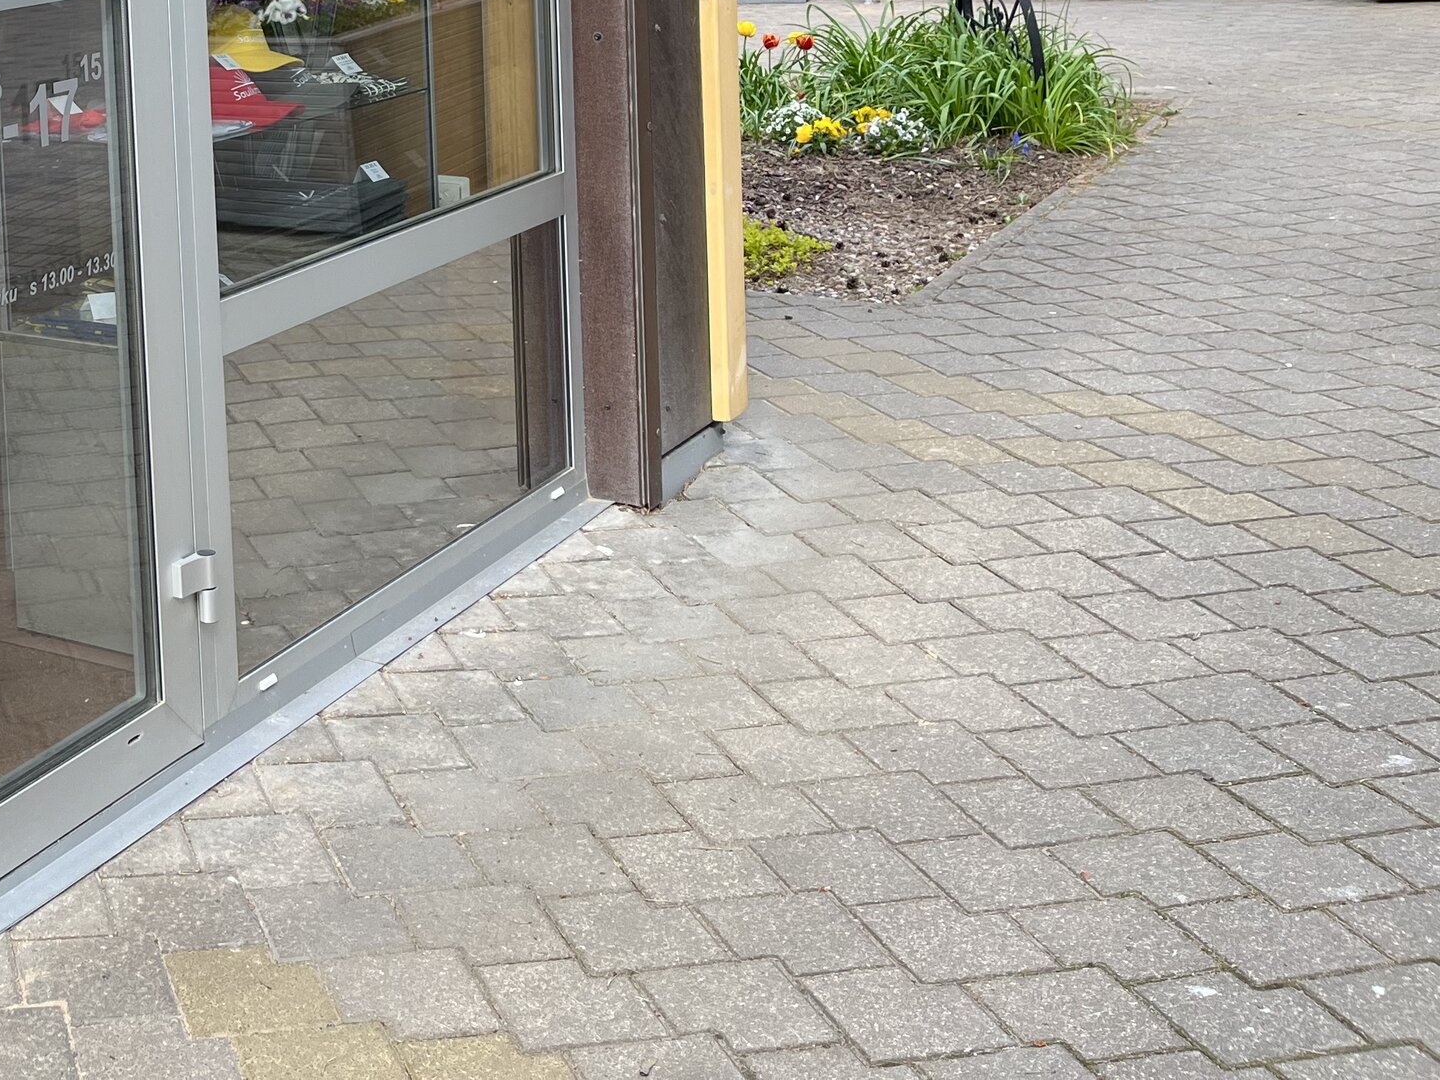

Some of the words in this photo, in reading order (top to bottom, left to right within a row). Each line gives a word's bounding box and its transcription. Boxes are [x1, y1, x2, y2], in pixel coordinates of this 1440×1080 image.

[29, 77, 79, 148] 17
[79, 51, 102, 82] 15
[41, 264, 75, 292] 13.00
[85, 252, 117, 276] 13.30
